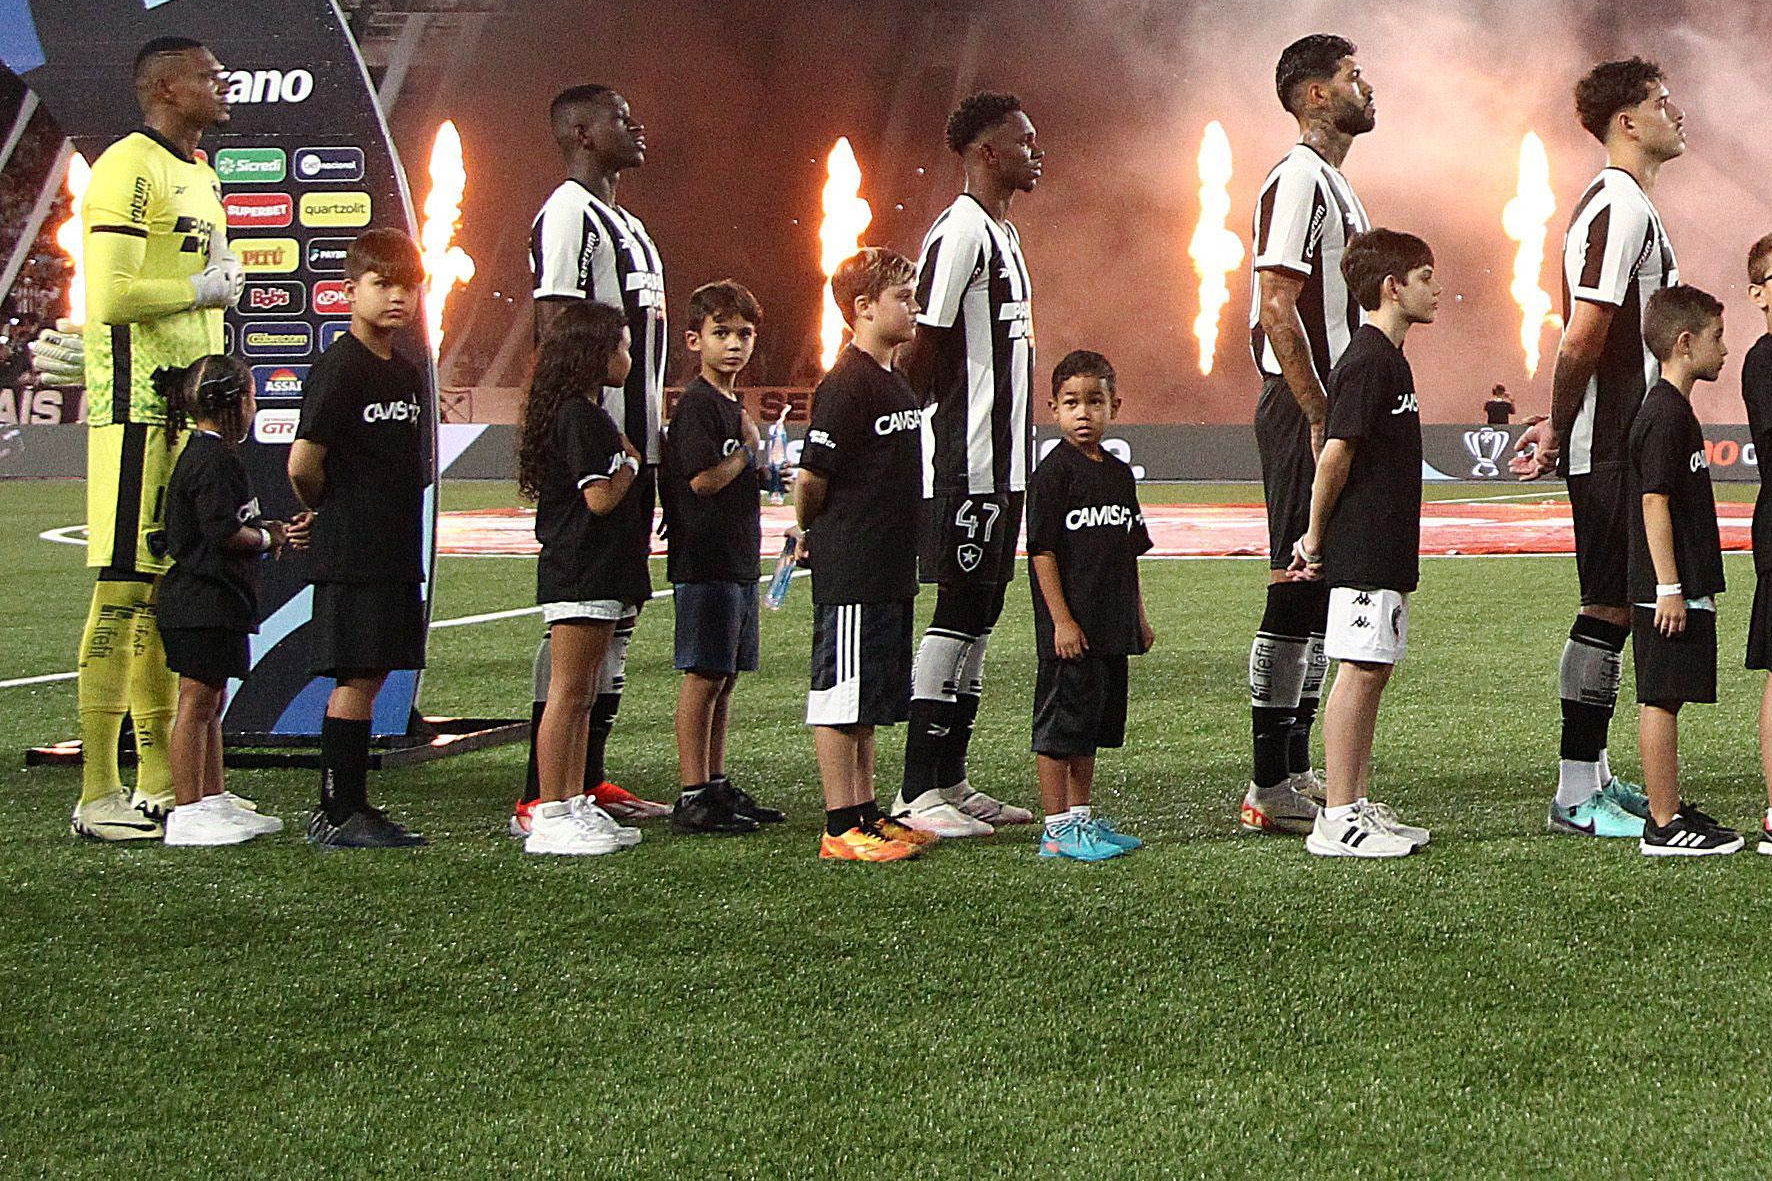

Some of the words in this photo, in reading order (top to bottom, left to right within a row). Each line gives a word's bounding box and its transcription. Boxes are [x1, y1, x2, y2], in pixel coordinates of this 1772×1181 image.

[235, 159, 282, 171] Sicredi
[228, 204, 288, 217] SUPERBET
[305, 202, 366, 215] quartzolit
[956, 500, 1000, 544] 47
